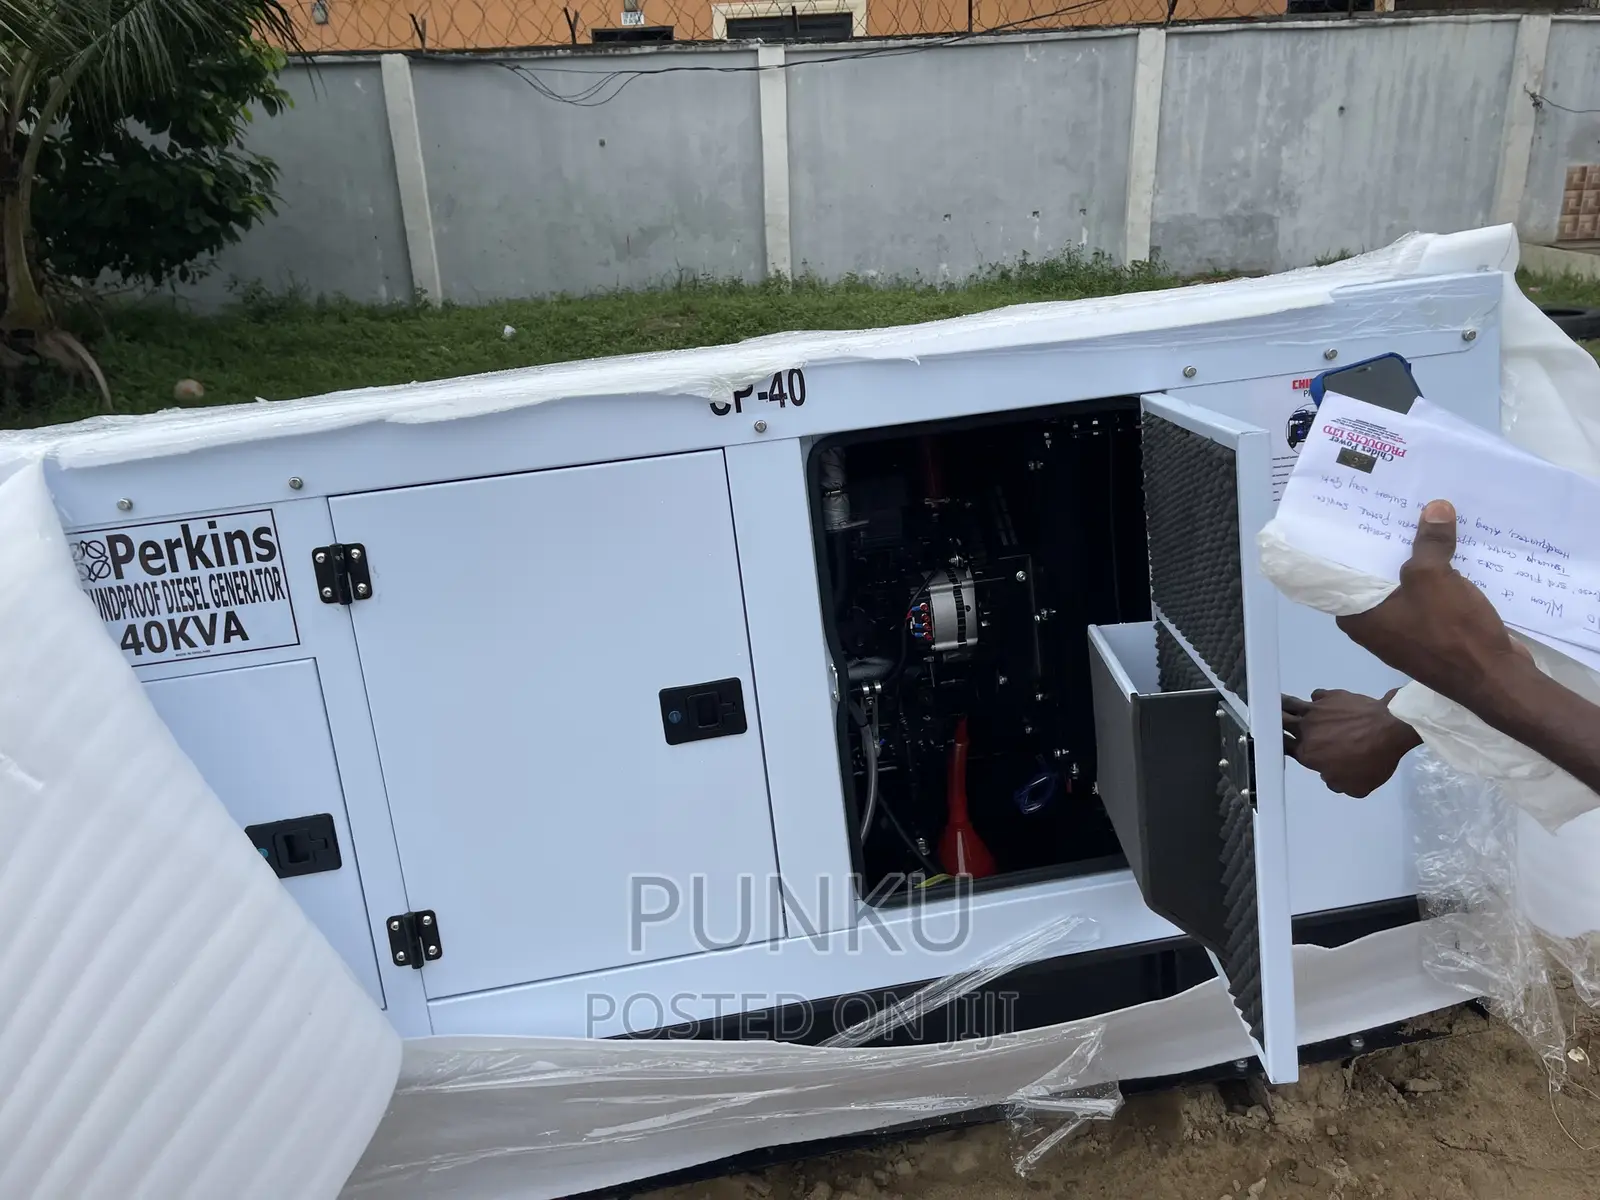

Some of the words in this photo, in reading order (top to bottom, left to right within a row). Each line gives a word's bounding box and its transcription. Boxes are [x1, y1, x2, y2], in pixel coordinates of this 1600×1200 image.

[1292, 379, 1313, 390] CHI
[1322, 424, 1346, 439] LTD
[1328, 435, 1360, 452] Power
[1344, 431, 1408, 459] PRODUCTS
[1359, 444, 1396, 463] Chidex
[106, 521, 277, 580] Perkins
[161, 575, 210, 611] DIESEL
[209, 566, 285, 609] GENERATOR
[1530, 596, 1564, 618] Whom
[121, 610, 249, 656] 40KVA
